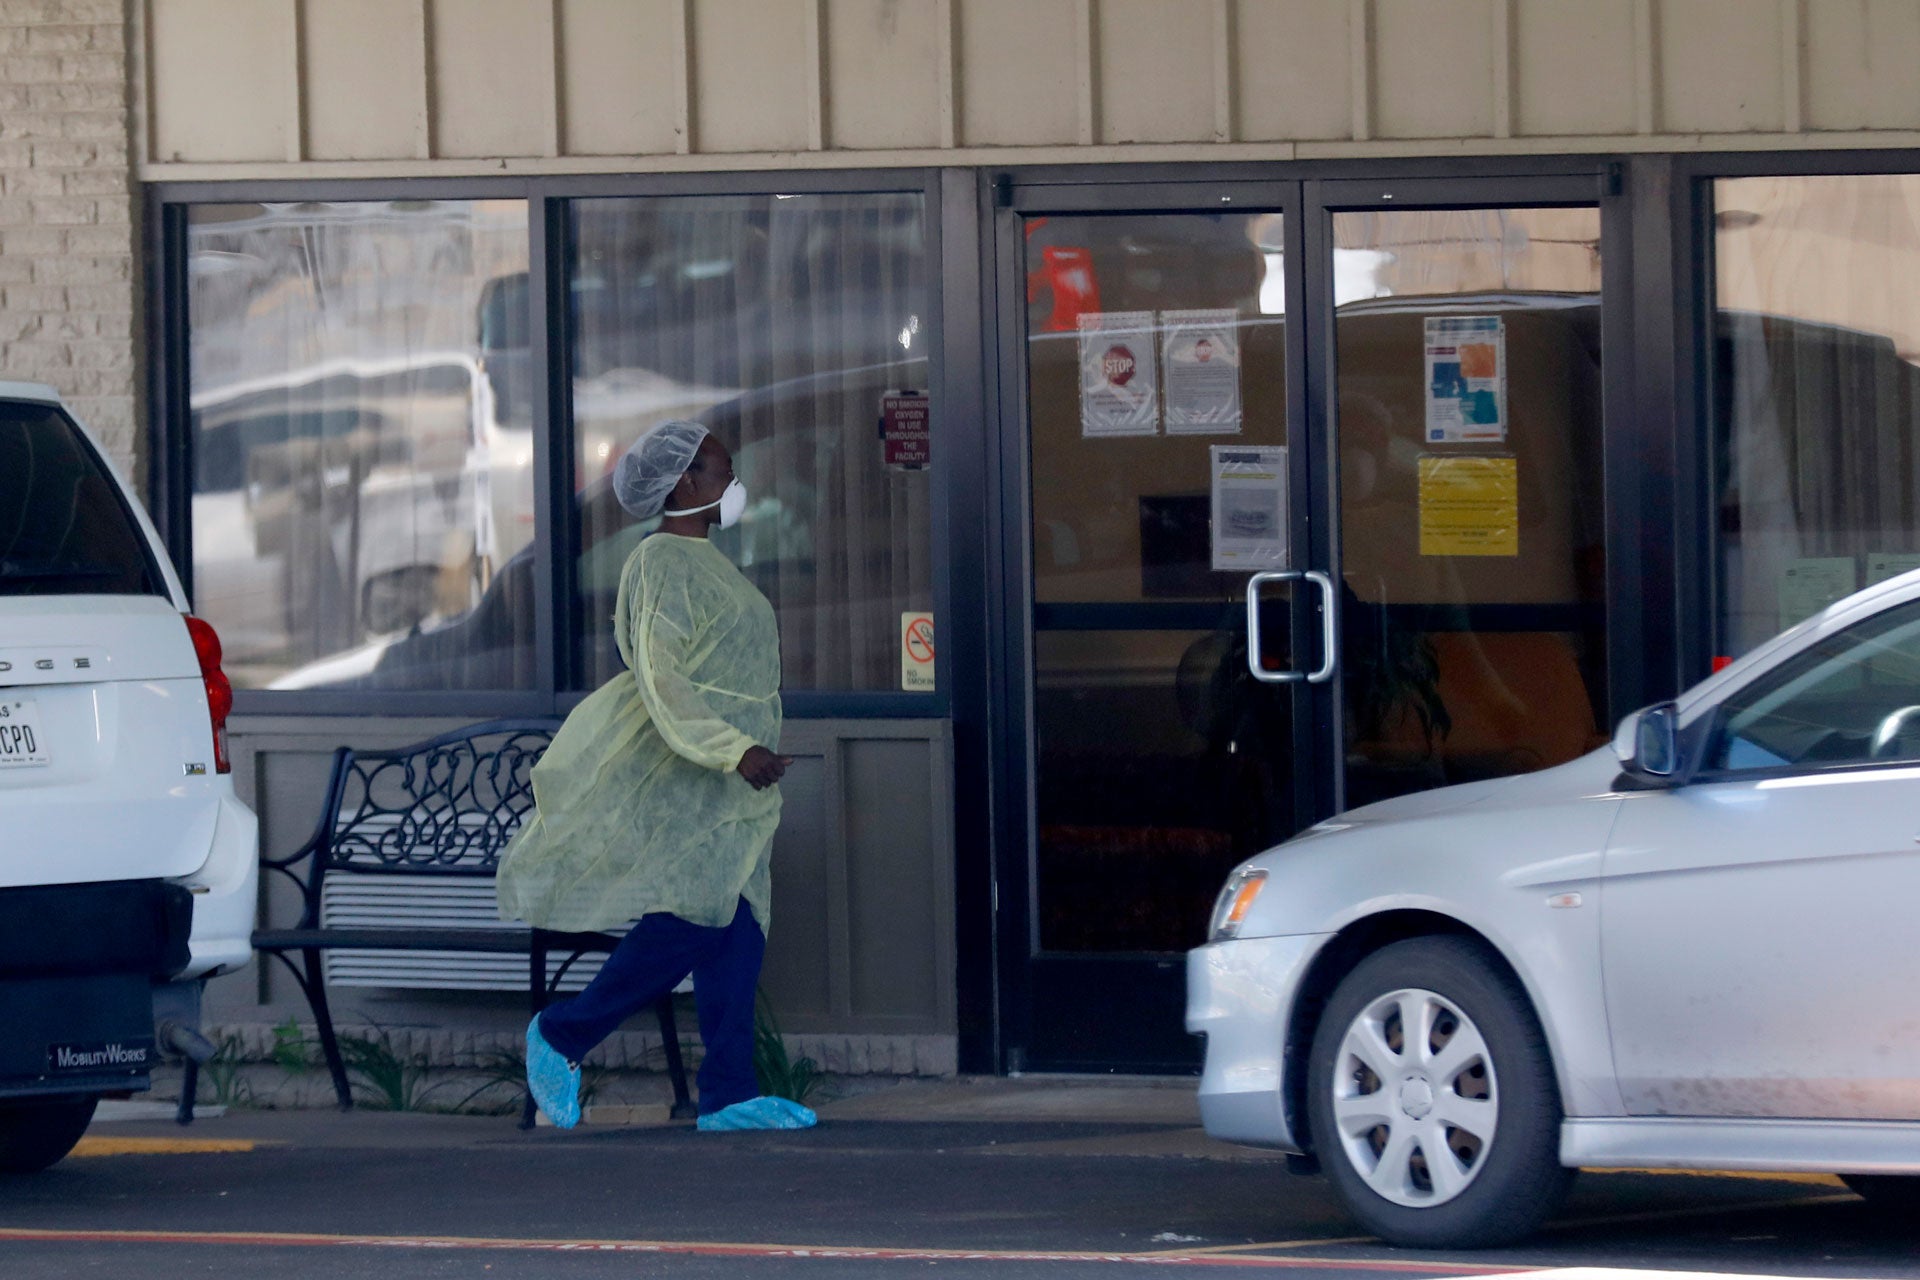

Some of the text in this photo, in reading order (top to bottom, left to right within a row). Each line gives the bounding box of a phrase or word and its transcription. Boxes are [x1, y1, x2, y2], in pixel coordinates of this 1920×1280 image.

[1105, 358, 1133, 374] STOP
[886, 400, 929, 409] NO SMOKIN
[894, 410, 924, 419] OXYGEN
[897, 421, 922, 430] IN USE
[885, 431, 931, 441] THROUGHOU
[902, 441, 917, 450] THE
[895, 452, 926, 461] FACILITY
[907, 677, 934, 686] SMOKIN
[0, 725, 36, 755] CPD
